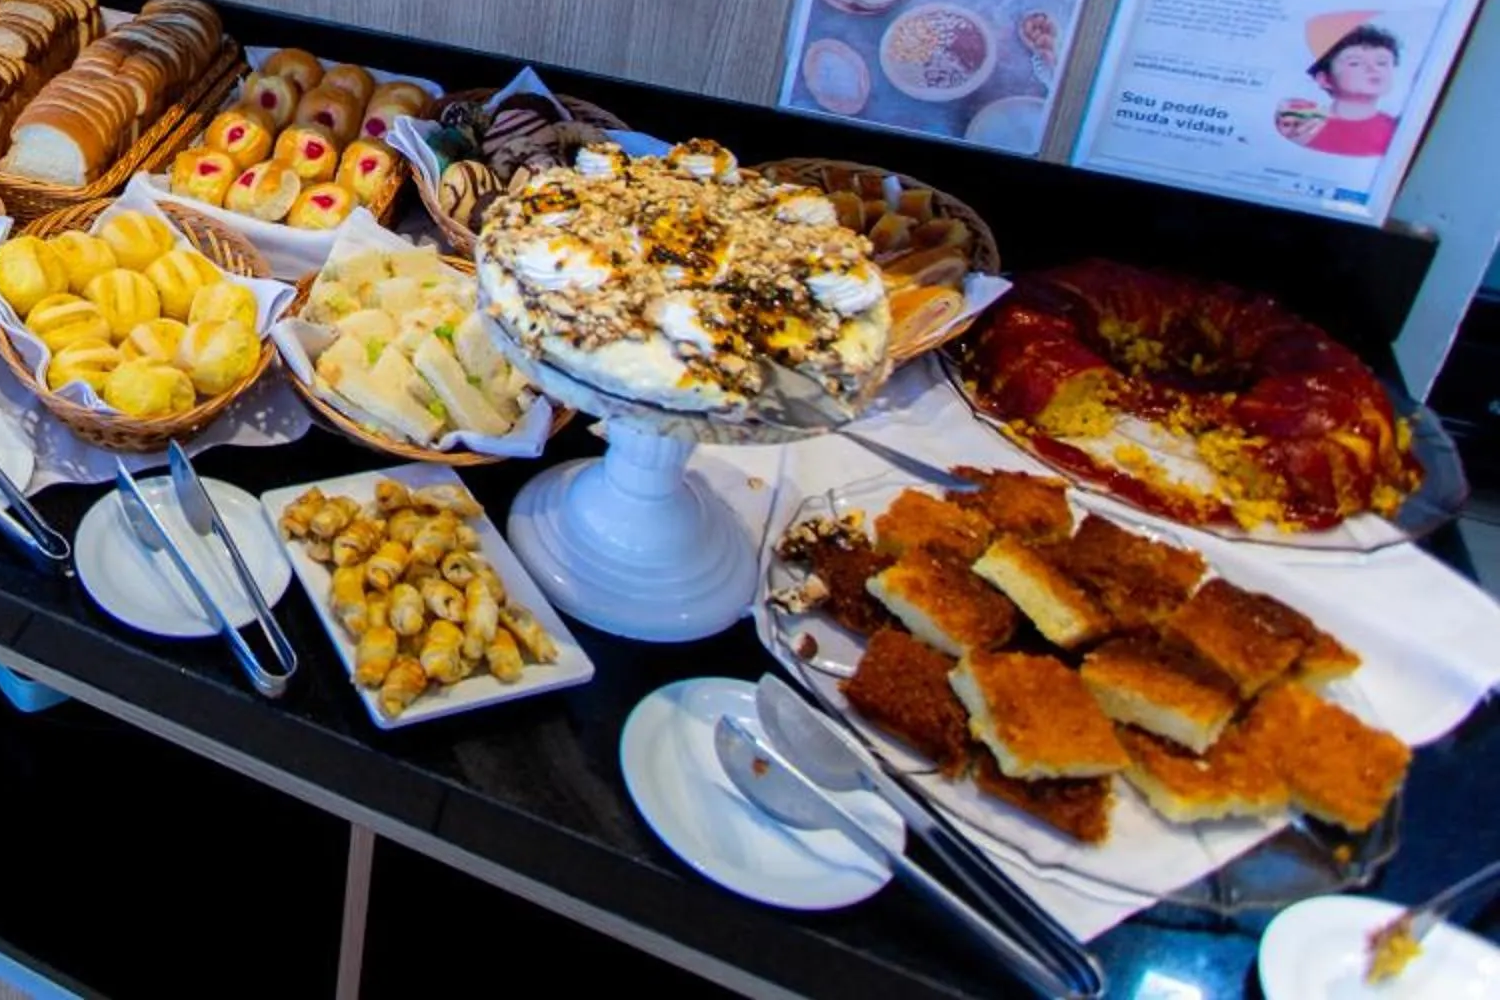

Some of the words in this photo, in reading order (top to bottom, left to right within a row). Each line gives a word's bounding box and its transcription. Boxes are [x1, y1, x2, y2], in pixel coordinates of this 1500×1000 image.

[1122, 90, 1156, 108] Seu
[1162, 99, 1229, 119] pedido
[1116, 107, 1169, 125] muda
[1176, 118, 1234, 136] vidas!
